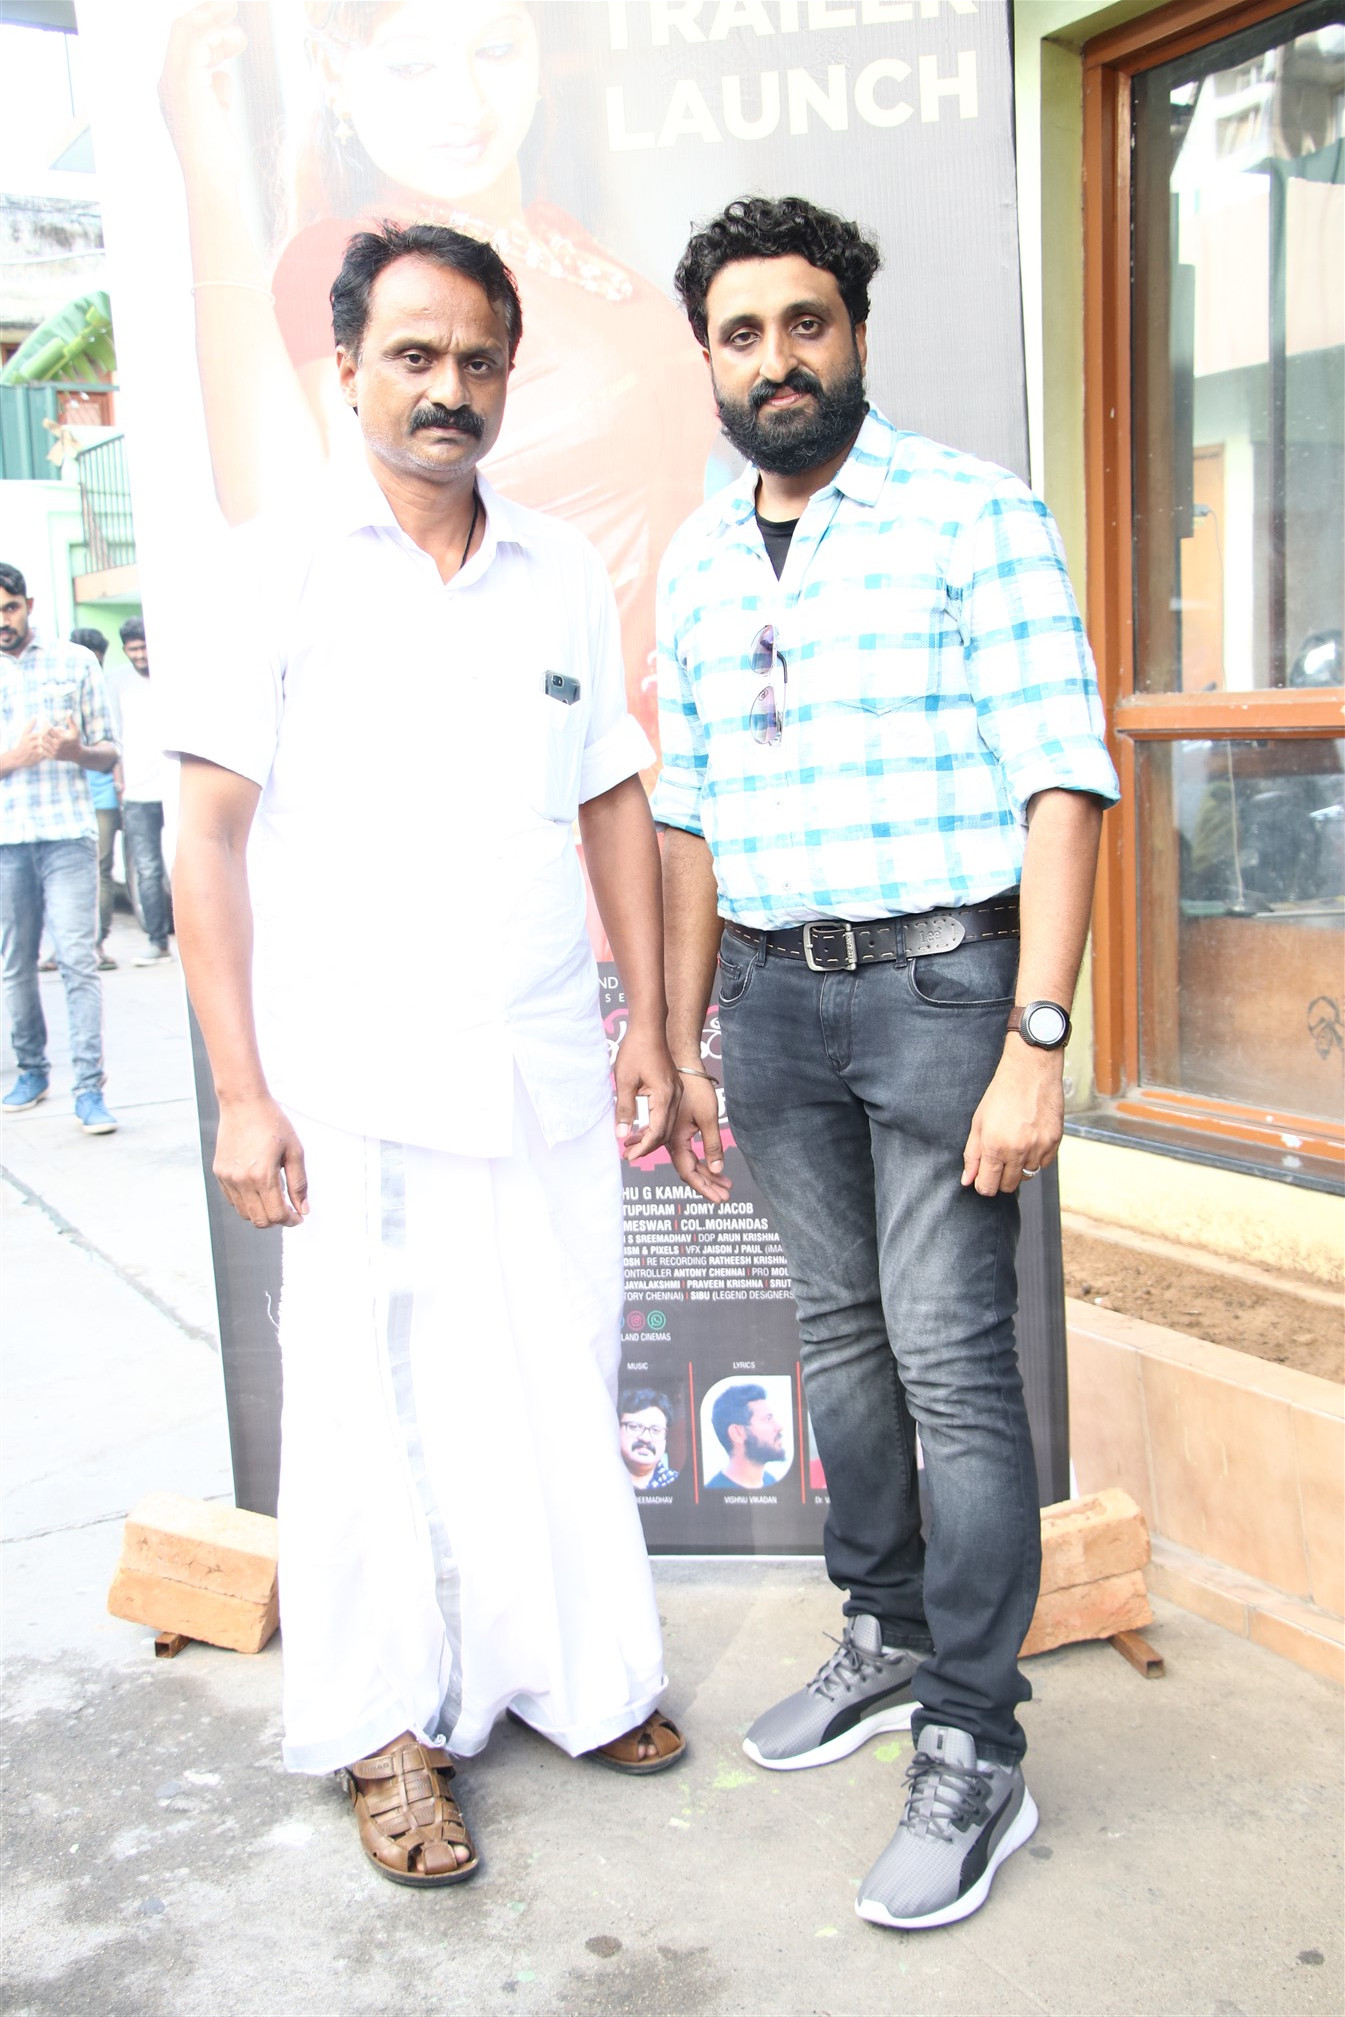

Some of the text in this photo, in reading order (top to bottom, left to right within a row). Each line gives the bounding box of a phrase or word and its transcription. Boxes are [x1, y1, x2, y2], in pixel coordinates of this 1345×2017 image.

[606, 0, 978, 51] TRAIL
[605, 51, 978, 152] LAUNCH
[642, 1186, 652, 1200] G
[684, 1203, 715, 1215] JOMY
[718, 1202, 754, 1215] JACOB
[624, 1218, 768, 1232] MESWAR COL.MOHANDAS
[628, 1234, 634, 1244] S
[636, 1233, 692, 1243] SREEMADHAV
[699, 1233, 716, 1242] DOP
[717, 1232, 741, 1242] ARUN
[743, 1232, 780, 1242] KRISHNA
[642, 1245, 649, 1255] &
[650, 1245, 680, 1255] PIXELS
[686, 1245, 701, 1254] VFX
[702, 1244, 733, 1254] JAISON
[734, 1244, 739, 1254] J
[741, 1244, 763, 1254] PAUL
[646, 1256, 658, 1266] RE
[660, 1256, 707, 1266] RECORDING
[709, 1255, 752, 1265] RATHEESH
[624, 1268, 672, 1278] ONTROLLER
[673, 1268, 707, 1278] ANTONY
[709, 1267, 746, 1277] CHENNAI
[752, 1267, 769, 1277] PRO
[624, 1280, 680, 1290] JAYALAKSHMI
[687, 1279, 725, 1289] PRAVEEN
[726, 1279, 764, 1289] KRISHNA
[690, 1290, 710, 1300] SIBU
[712, 1290, 748, 1301] (LEGEND
[640, 1332, 672, 1341] CINEMAS
[627, 1361, 649, 1370] MUSIC
[732, 1361, 756, 1369] LYRICS
